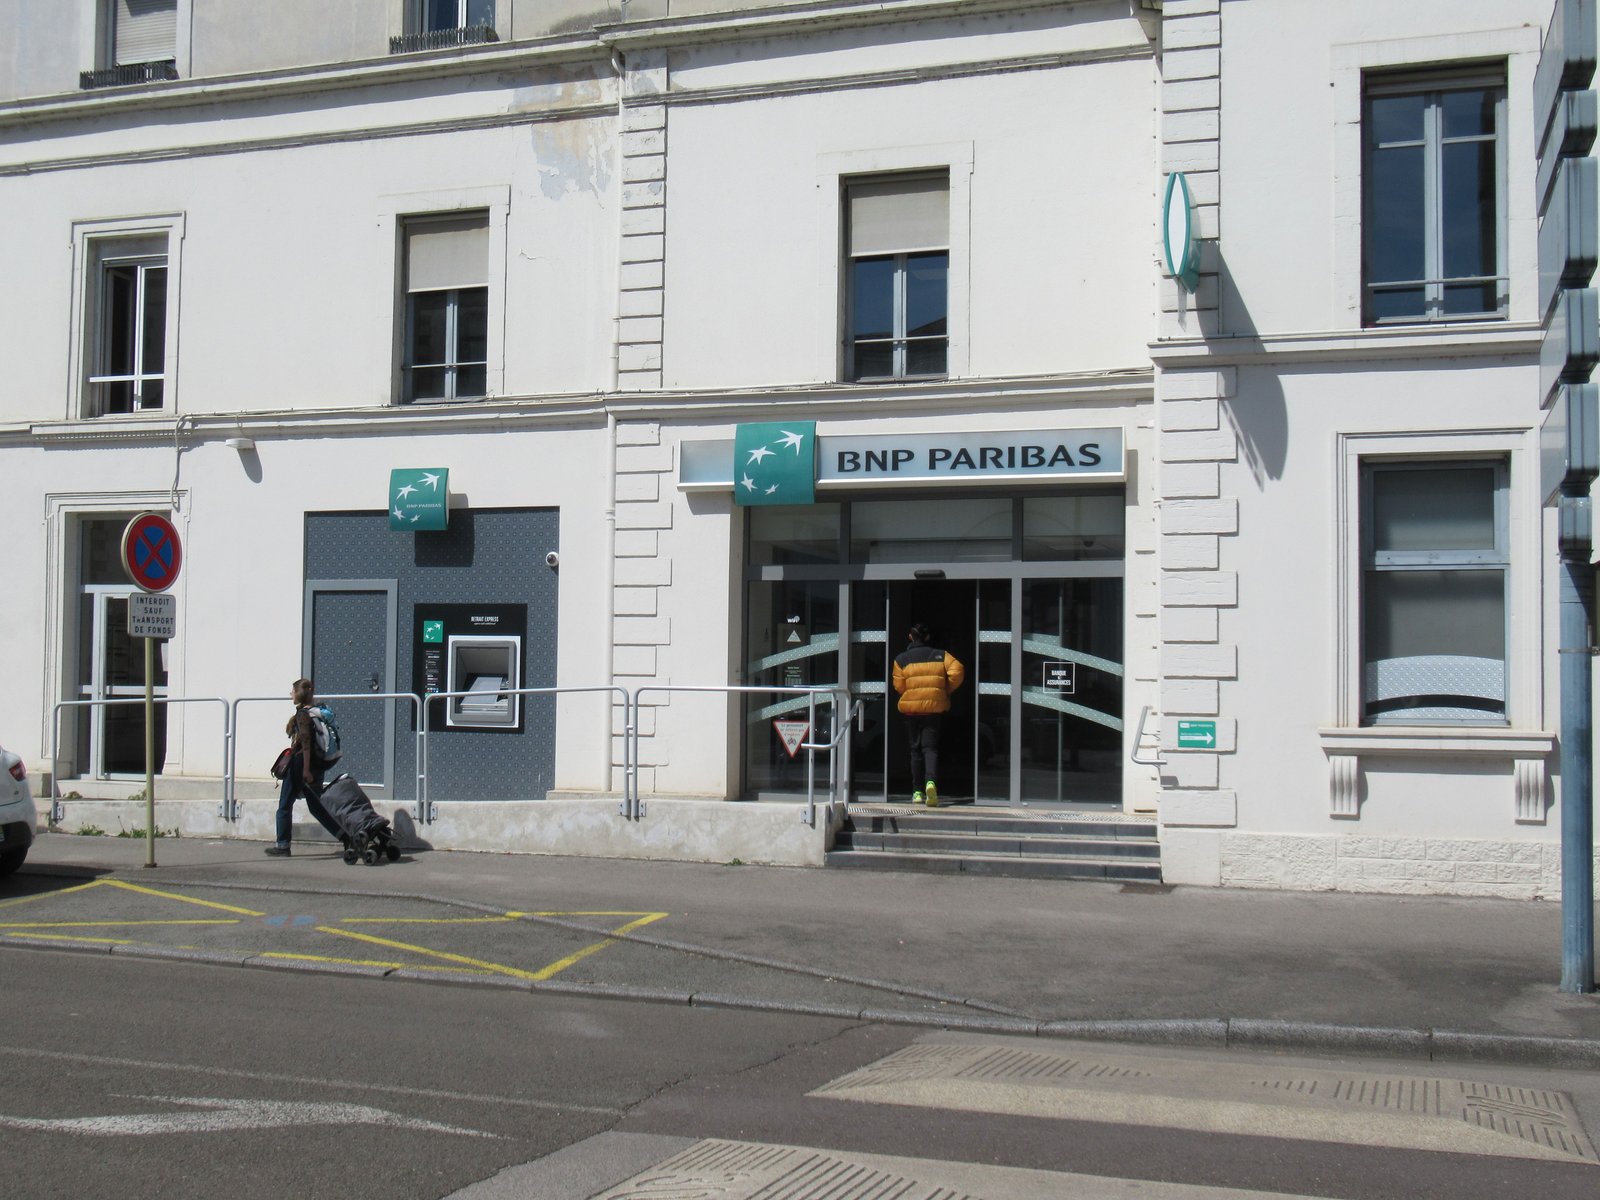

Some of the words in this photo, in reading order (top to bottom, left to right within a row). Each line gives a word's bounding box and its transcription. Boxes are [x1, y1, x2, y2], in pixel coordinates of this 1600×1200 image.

[837, 449, 915, 473] BNP
[928, 443, 1101, 470] PARIBAS
[136, 597, 169, 605] INTERDIT
